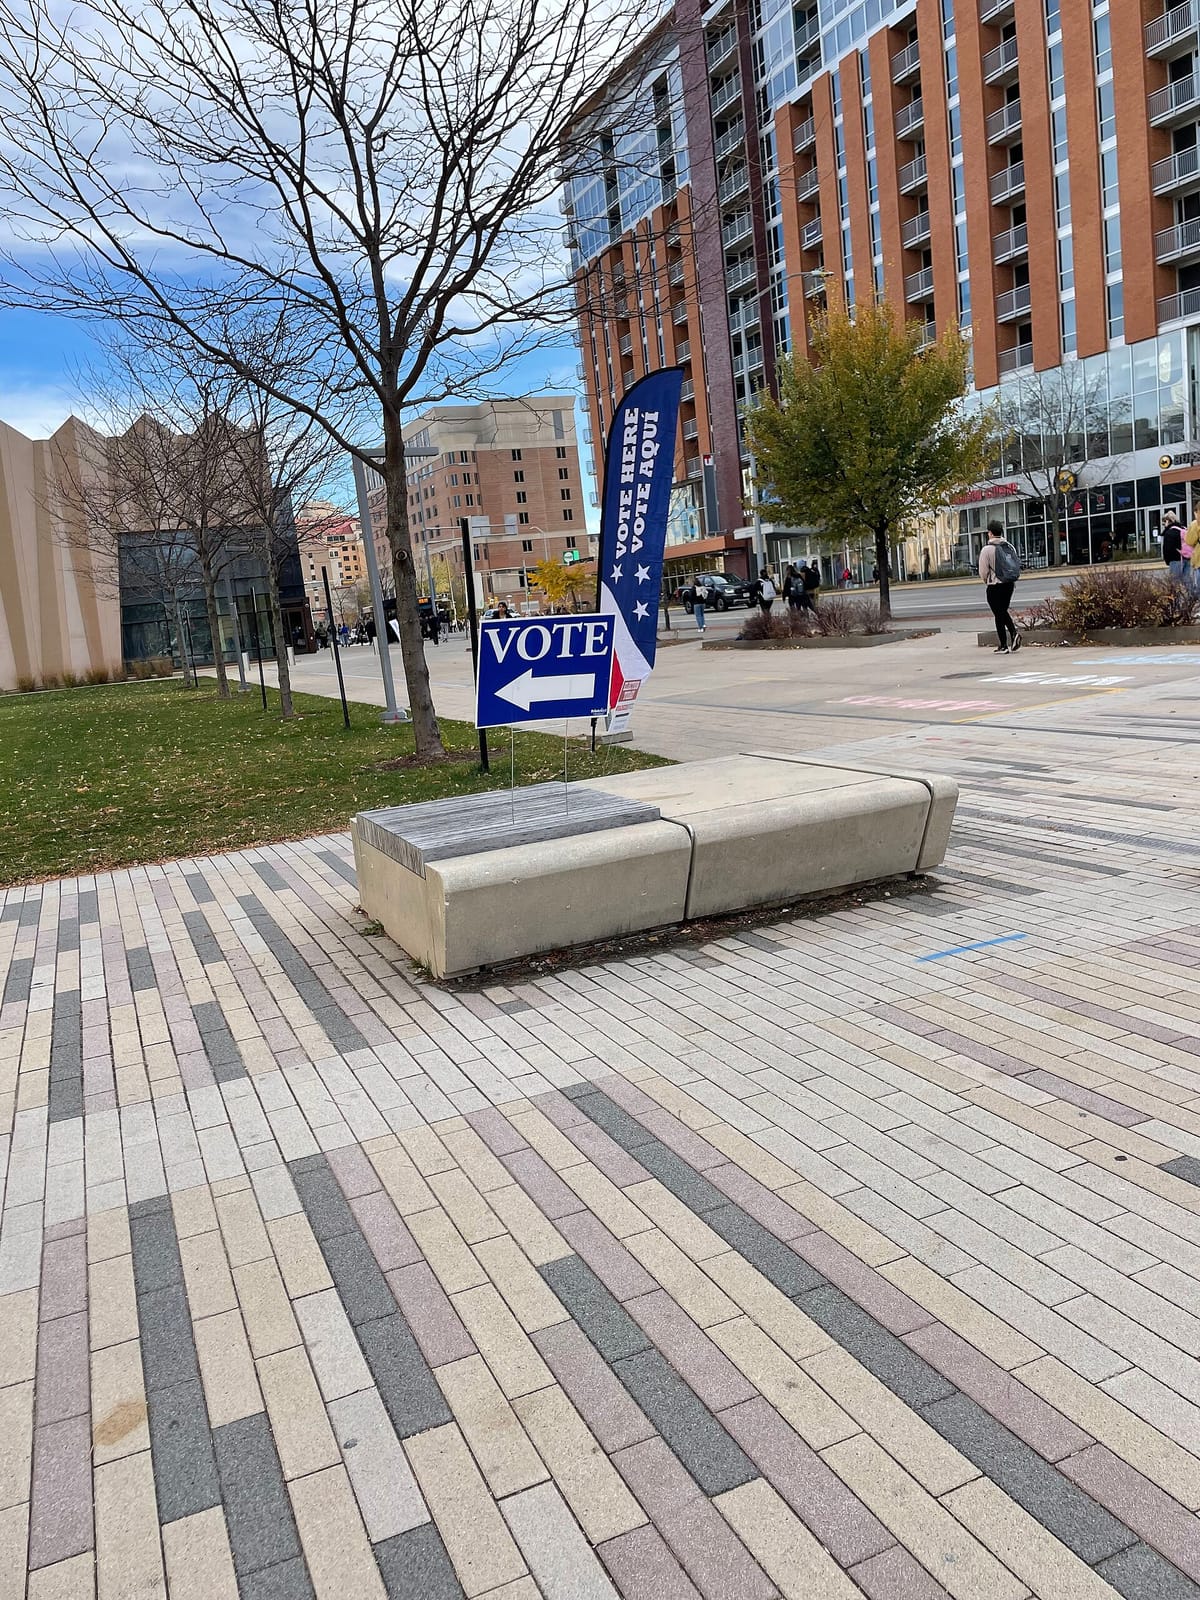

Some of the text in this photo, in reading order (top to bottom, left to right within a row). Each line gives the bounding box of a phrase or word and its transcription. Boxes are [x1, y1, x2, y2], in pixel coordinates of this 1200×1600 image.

[615, 408, 639, 559] VOTE HERE
[631, 411, 660, 553] VOTE AQUÍ
[484, 621, 609, 664] VOTE
